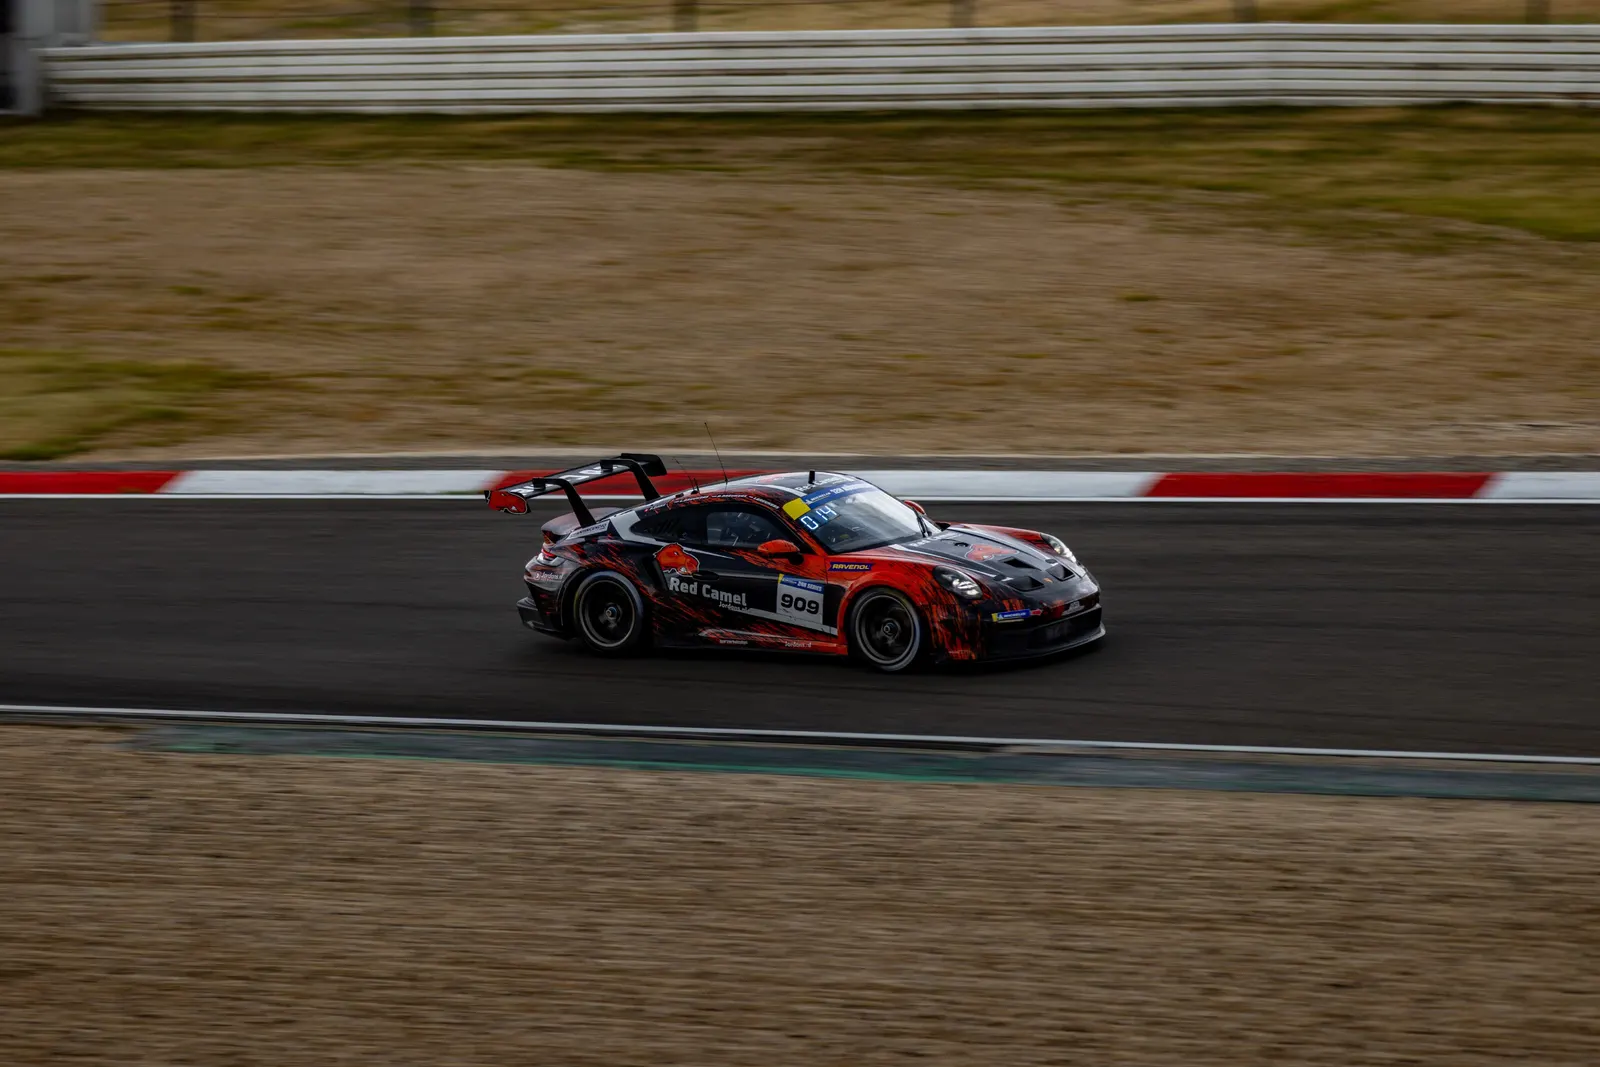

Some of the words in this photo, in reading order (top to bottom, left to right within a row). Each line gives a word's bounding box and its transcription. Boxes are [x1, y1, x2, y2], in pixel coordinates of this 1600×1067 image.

[669, 577, 698, 595] Red
[702, 584, 747, 606] Camel
[780, 593, 820, 615] 909
